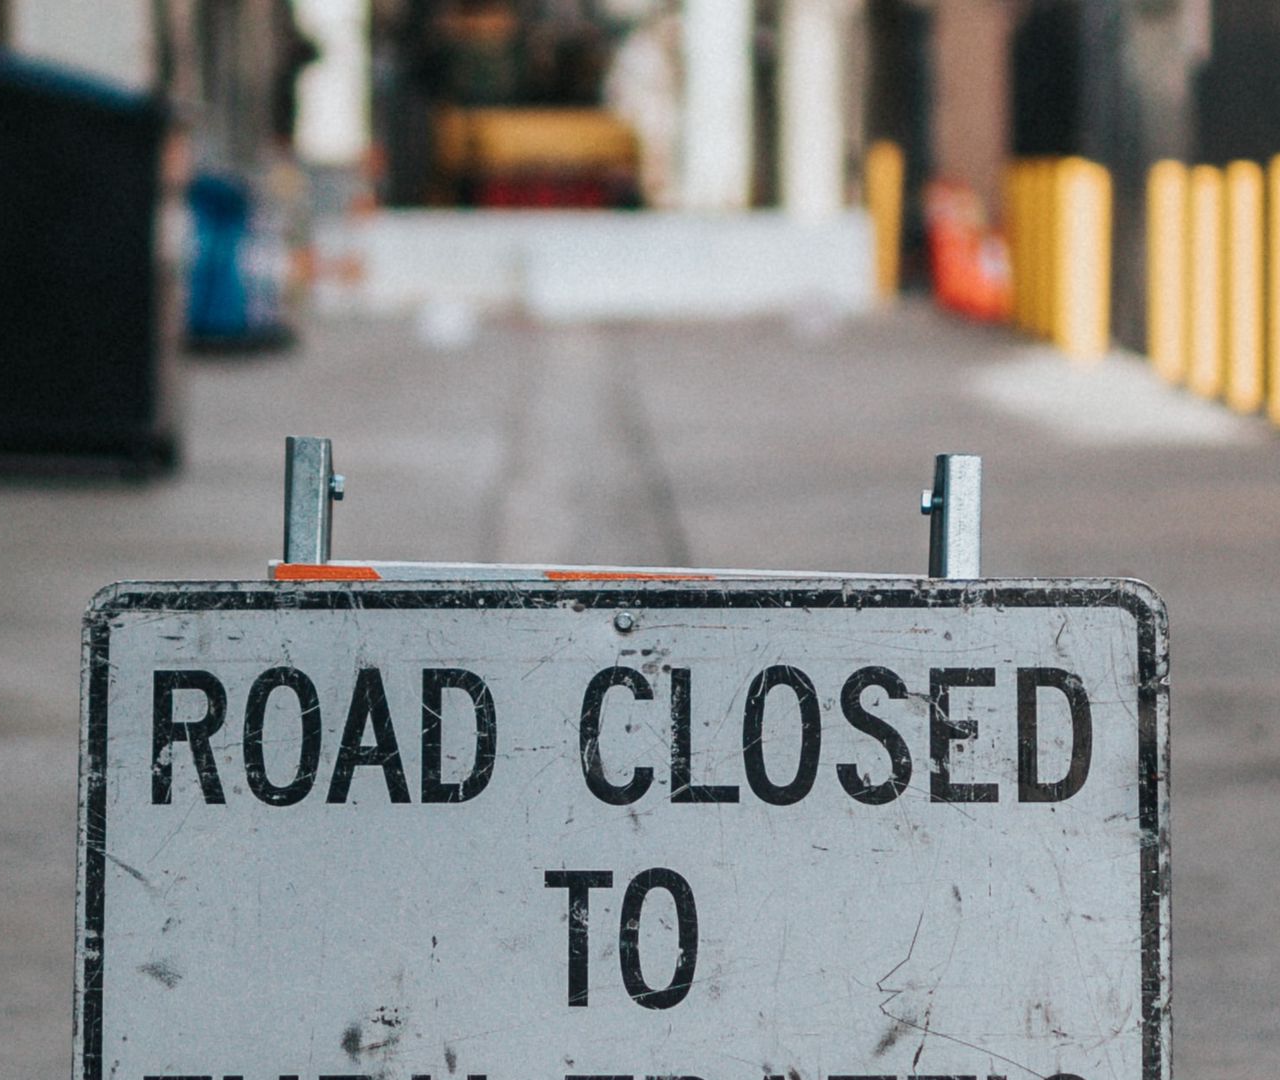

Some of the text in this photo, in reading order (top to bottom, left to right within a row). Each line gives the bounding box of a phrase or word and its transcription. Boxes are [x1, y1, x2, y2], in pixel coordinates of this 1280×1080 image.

[151, 664, 1093, 806] ROAD CLOSED
[543, 866, 699, 1010] TO
